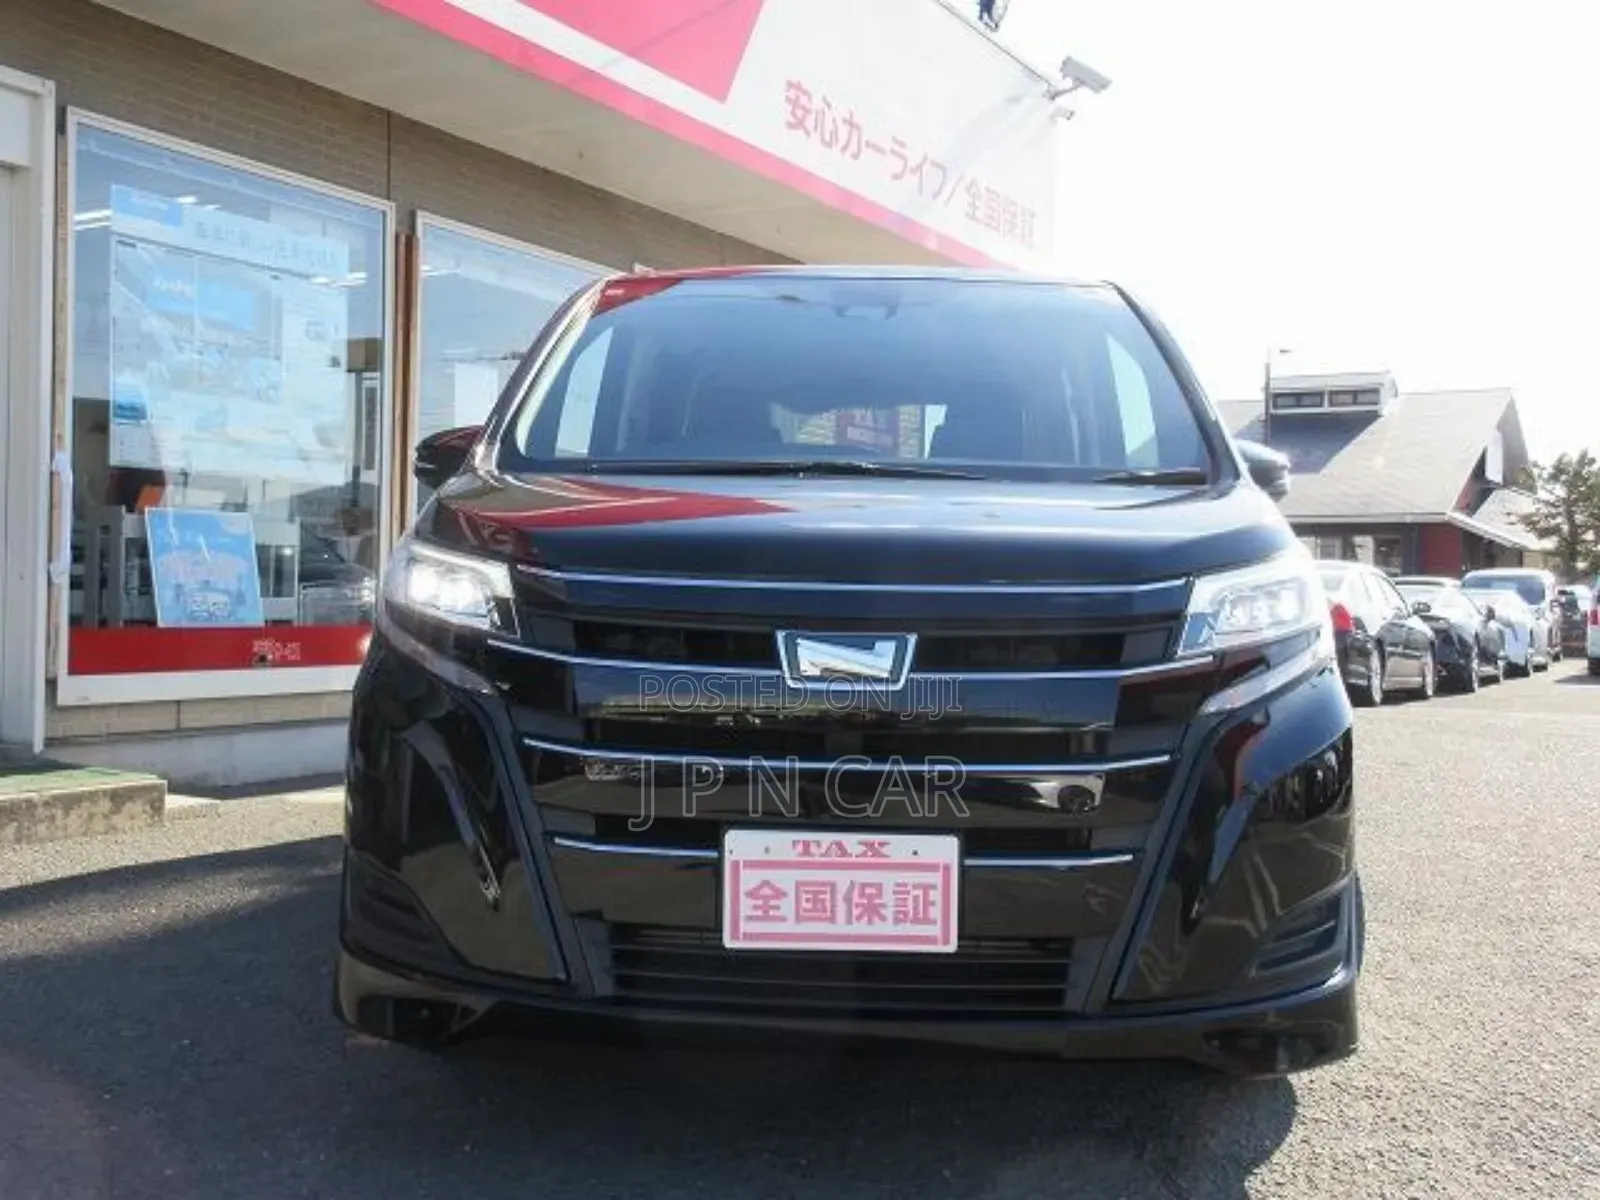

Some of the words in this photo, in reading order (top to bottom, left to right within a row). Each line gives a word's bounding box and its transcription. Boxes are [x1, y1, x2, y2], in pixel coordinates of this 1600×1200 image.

[792, 839, 891, 859] TAX
[744, 879, 938, 925] 全国保証
